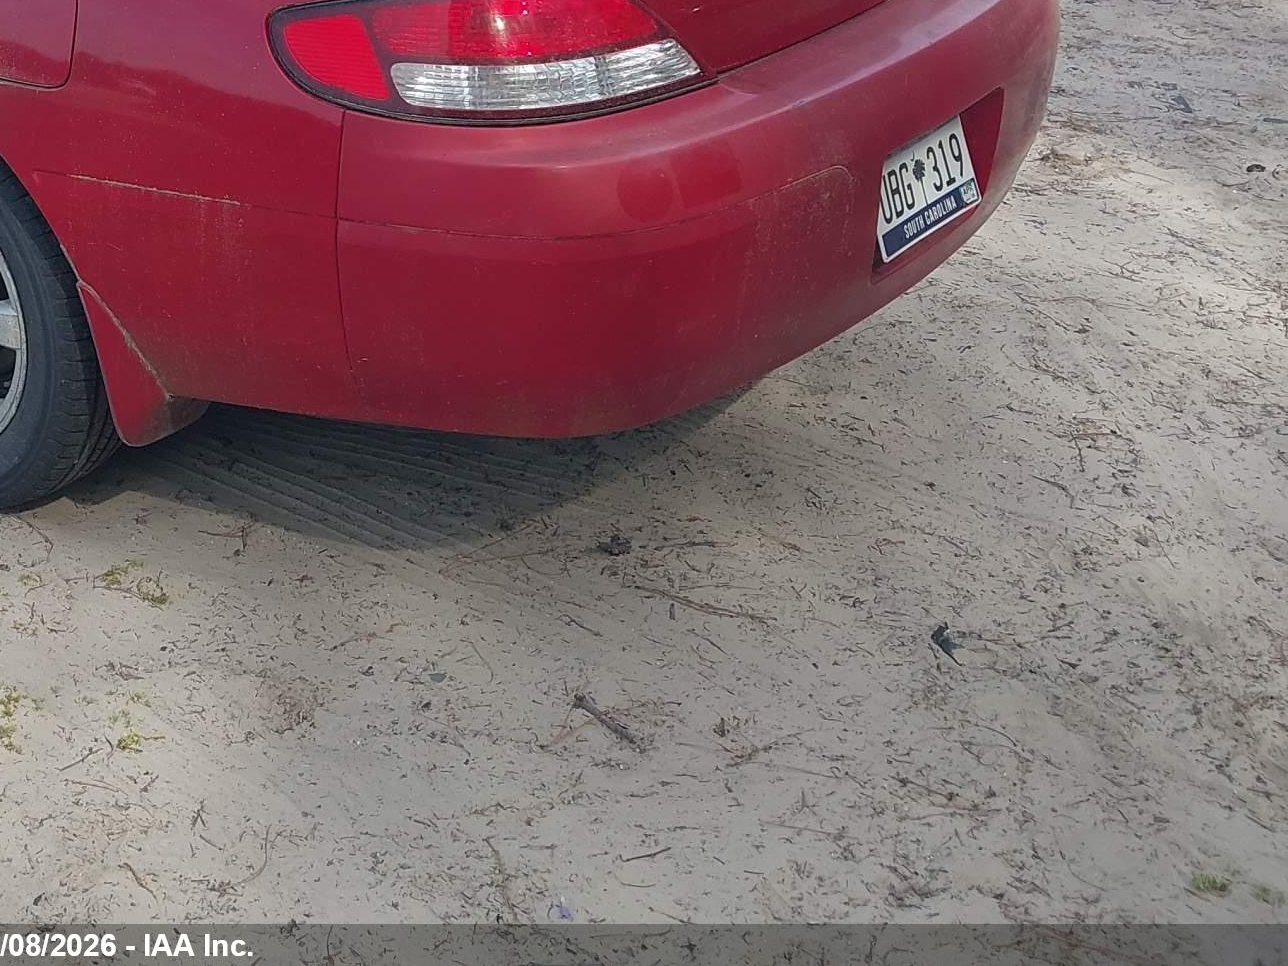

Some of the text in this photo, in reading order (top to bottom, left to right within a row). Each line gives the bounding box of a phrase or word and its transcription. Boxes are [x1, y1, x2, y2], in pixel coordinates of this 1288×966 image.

[926, 133, 964, 192] 319
[903, 195, 957, 238] SOUTH CAROLINA
